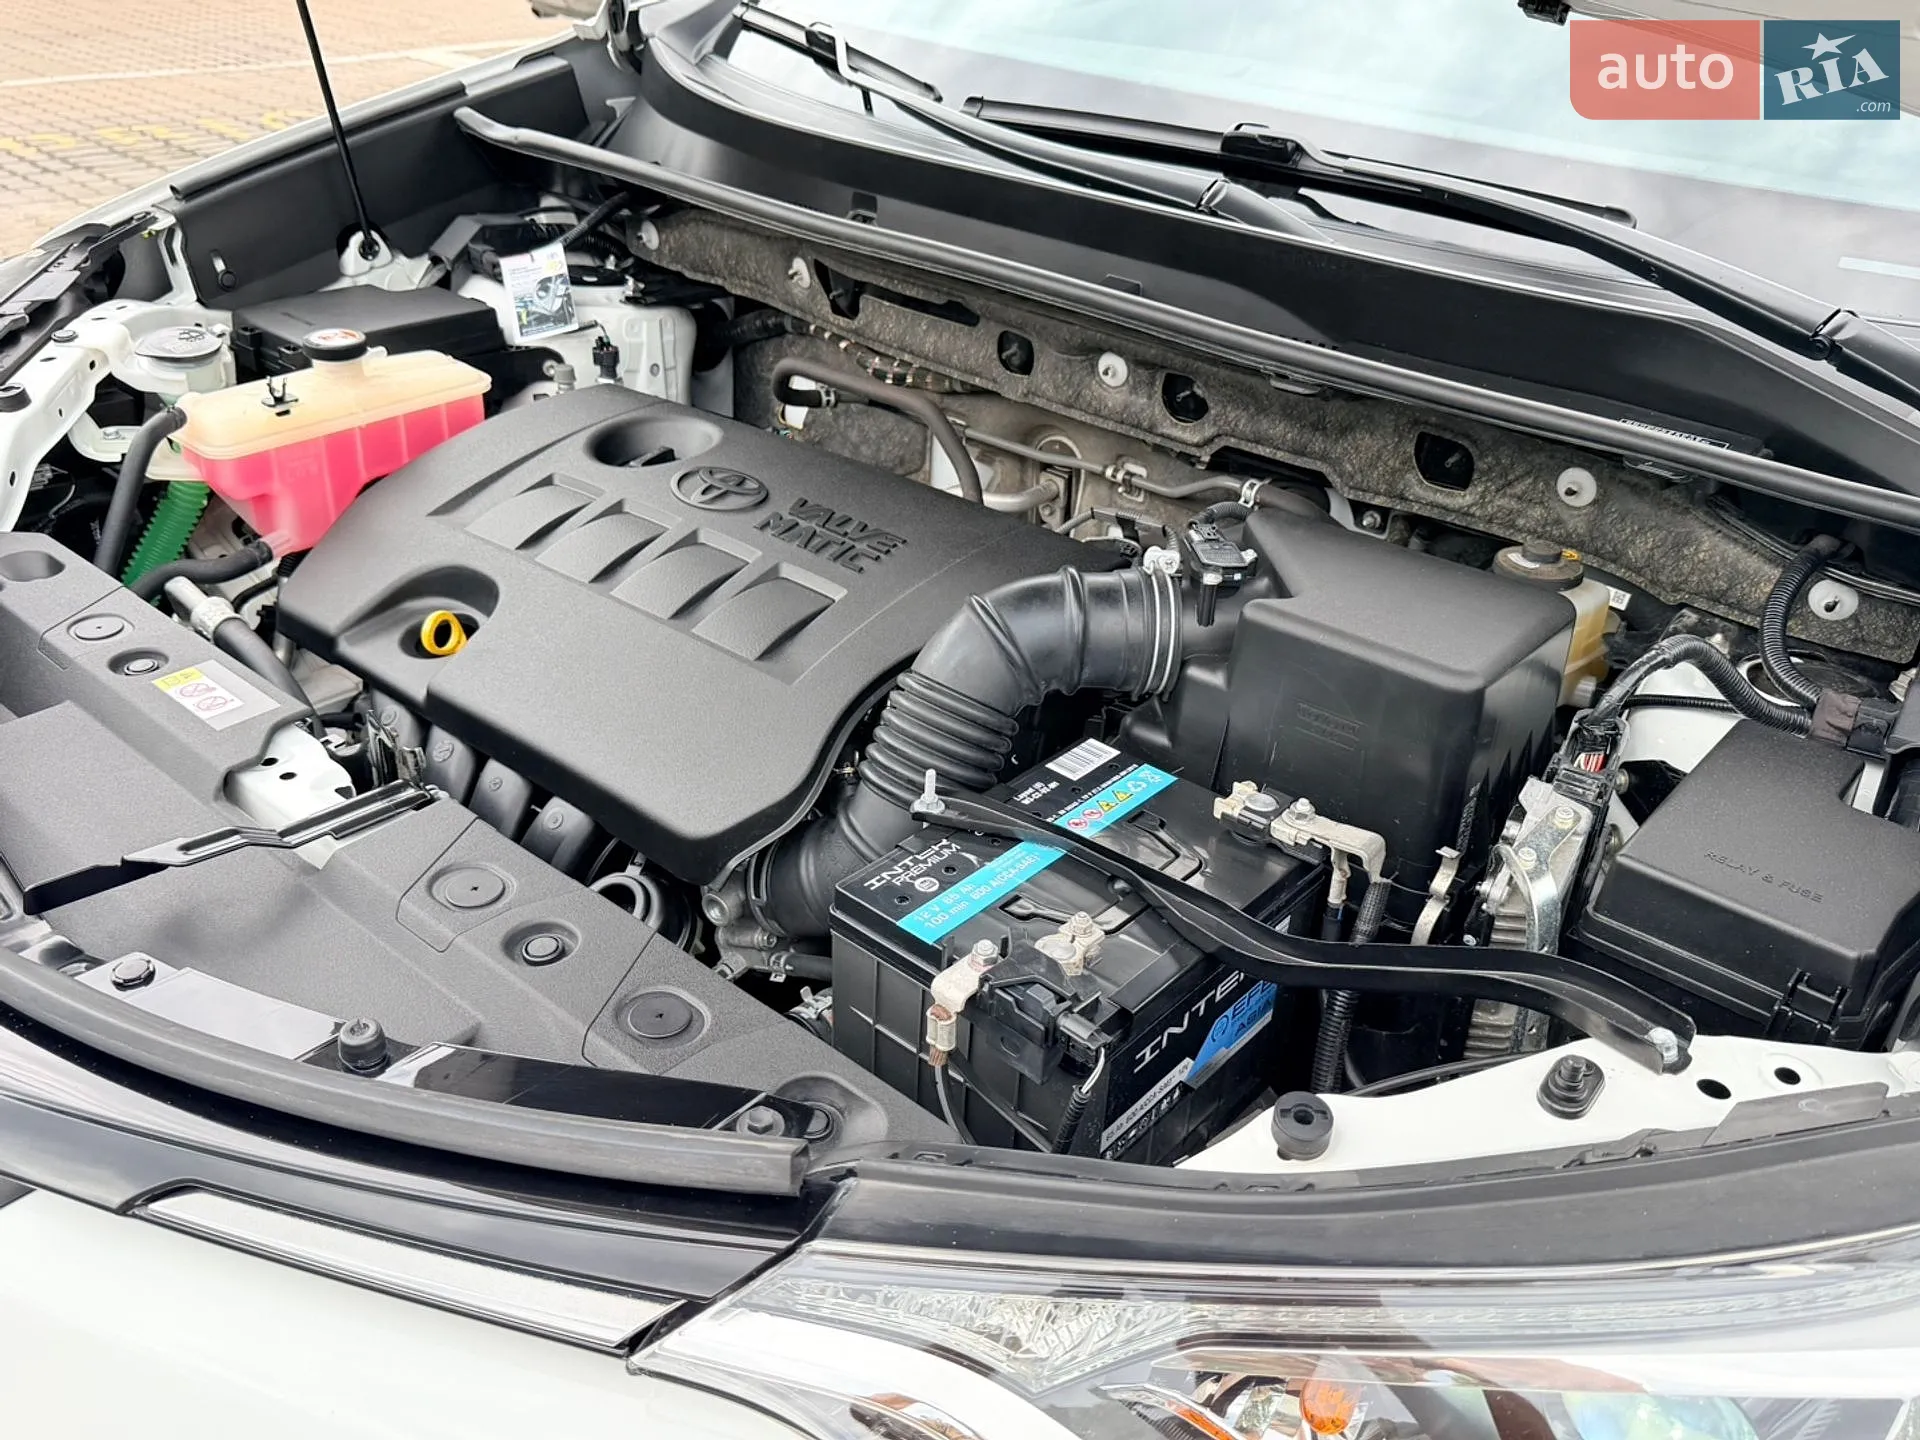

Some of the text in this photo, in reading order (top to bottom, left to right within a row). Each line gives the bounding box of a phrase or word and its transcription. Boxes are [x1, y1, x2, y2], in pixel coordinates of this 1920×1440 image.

[753, 511, 881, 574] MATIC
[788, 497, 907, 555] VALVE
[891, 842, 961, 887] PREMIUM
[1703, 848, 1824, 903] RELAY & FUSE
[923, 912, 949, 929] 100
